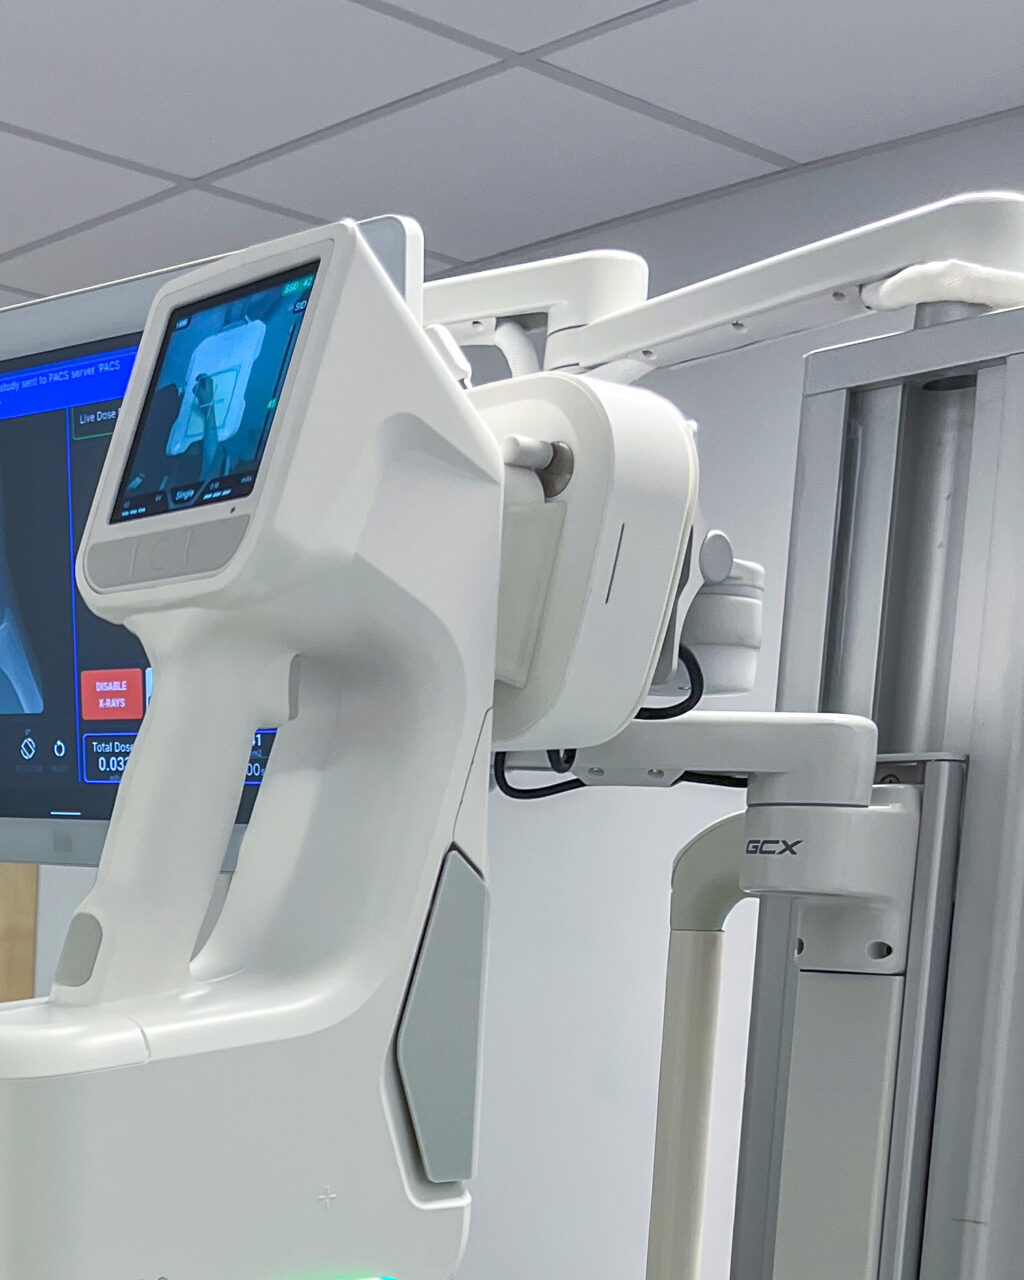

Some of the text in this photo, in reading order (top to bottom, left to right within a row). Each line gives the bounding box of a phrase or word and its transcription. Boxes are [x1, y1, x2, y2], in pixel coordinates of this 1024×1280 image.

[0, 381, 20, 393] study
[22, 377, 37, 389] sent
[39, 374, 48, 385] to
[48, 371, 69, 384] PACS
[71, 366, 95, 379] server
[80, 410, 116, 425] Live Dose
[96, 681, 127, 692] DISABLE
[99, 698, 125, 708] X-RAYS
[92, 742, 113, 753] Total
[98, 757, 130, 771] 0.03
[745, 839, 804, 855] GCX
